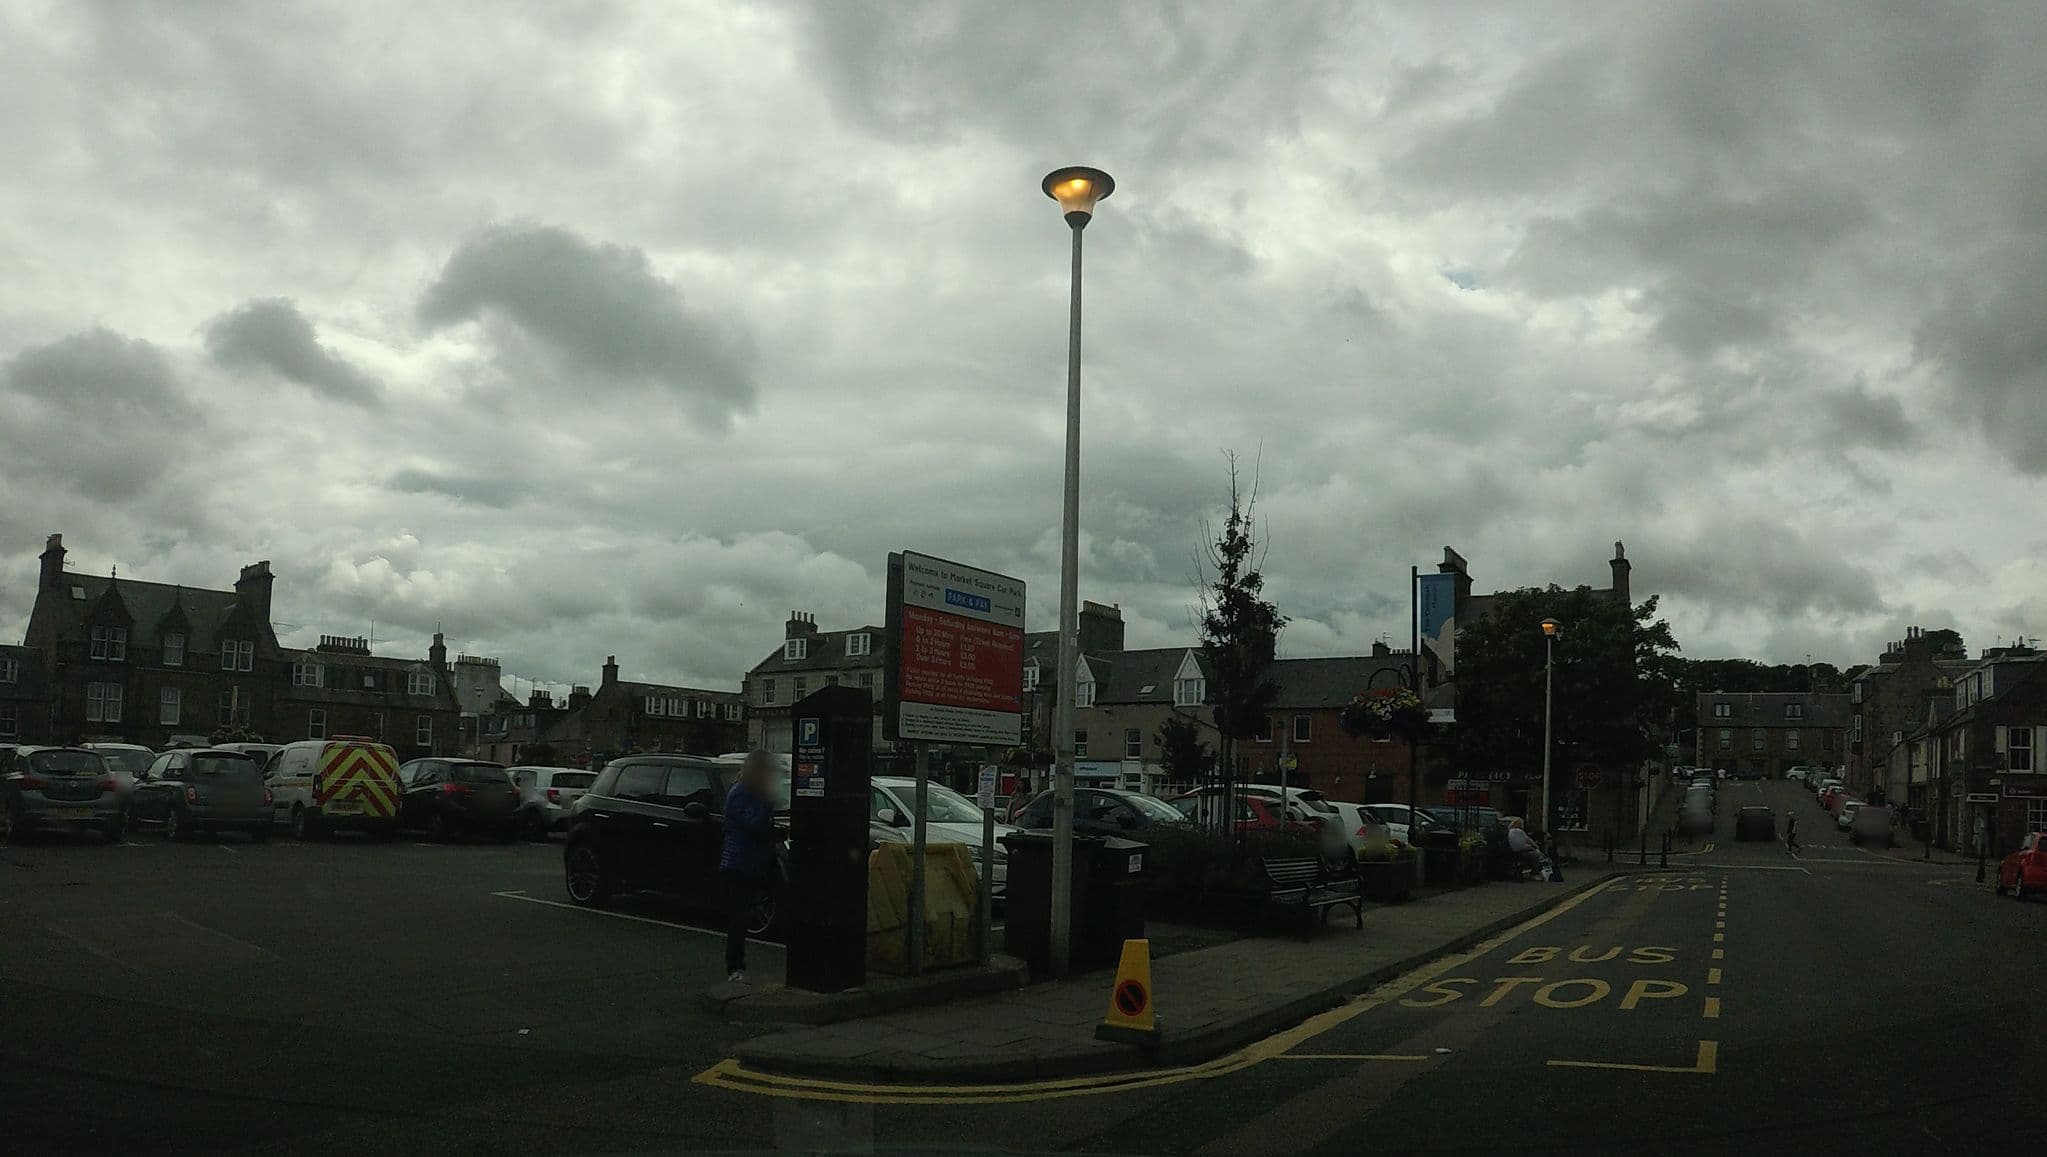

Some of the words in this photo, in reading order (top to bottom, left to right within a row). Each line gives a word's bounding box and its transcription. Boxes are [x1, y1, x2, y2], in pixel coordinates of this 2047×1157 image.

[909, 563, 938, 577] Welcome
[941, 571, 948, 579] to
[951, 573, 972, 585] Market
[974, 579, 995, 591] Square
[997, 584, 1007, 593] Car
[1009, 587, 1021, 597] Park
[947, 592, 966, 603] PARK
[968, 597, 974, 606] &
[976, 598, 988, 609] PAY
[909, 611, 933, 624] Monday
[939, 617, 965, 630] Saturday
[804, 722, 816, 741] P
[1506, 945, 1680, 964] BUS
[1400, 977, 1689, 1010] STOP
